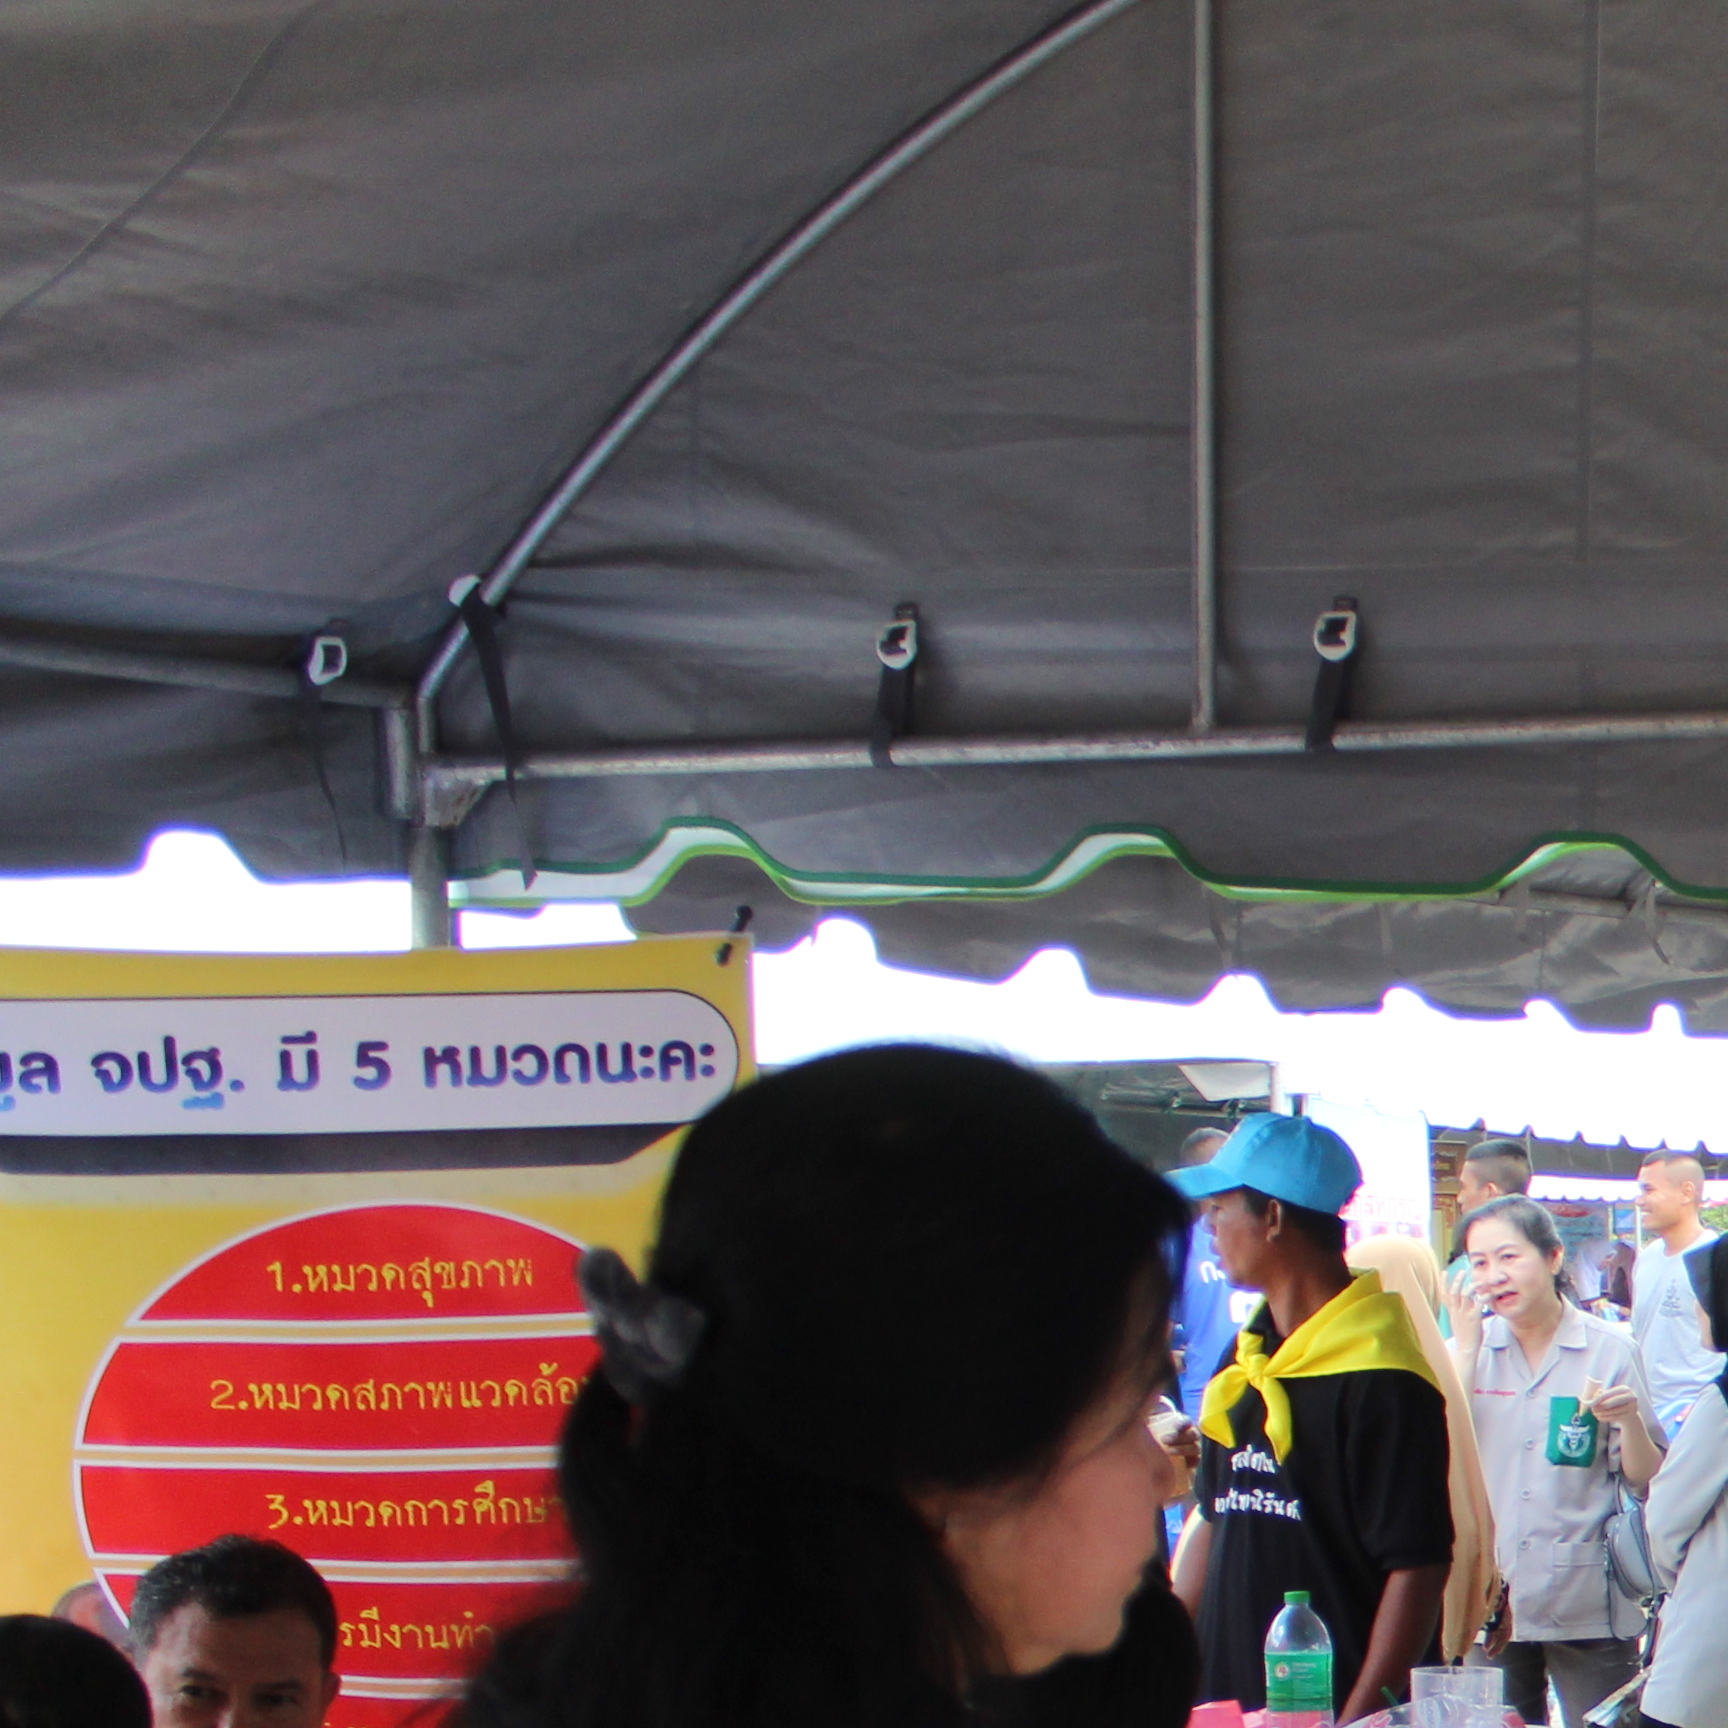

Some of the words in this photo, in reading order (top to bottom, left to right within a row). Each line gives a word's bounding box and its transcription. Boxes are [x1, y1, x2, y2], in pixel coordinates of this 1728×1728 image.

[90, 1036, 245, 1109] จปฐ.
[276, 1030, 321, 1091] มี
[353, 1041, 391, 1090] 5
[421, 1040, 716, 1089] หมวดนะคะ
[266, 1257, 534, 1307] 1.หมวดสุขภาพ
[210, 1362, 590, 1412] 2.หมวดสภาพแวดล้อ
